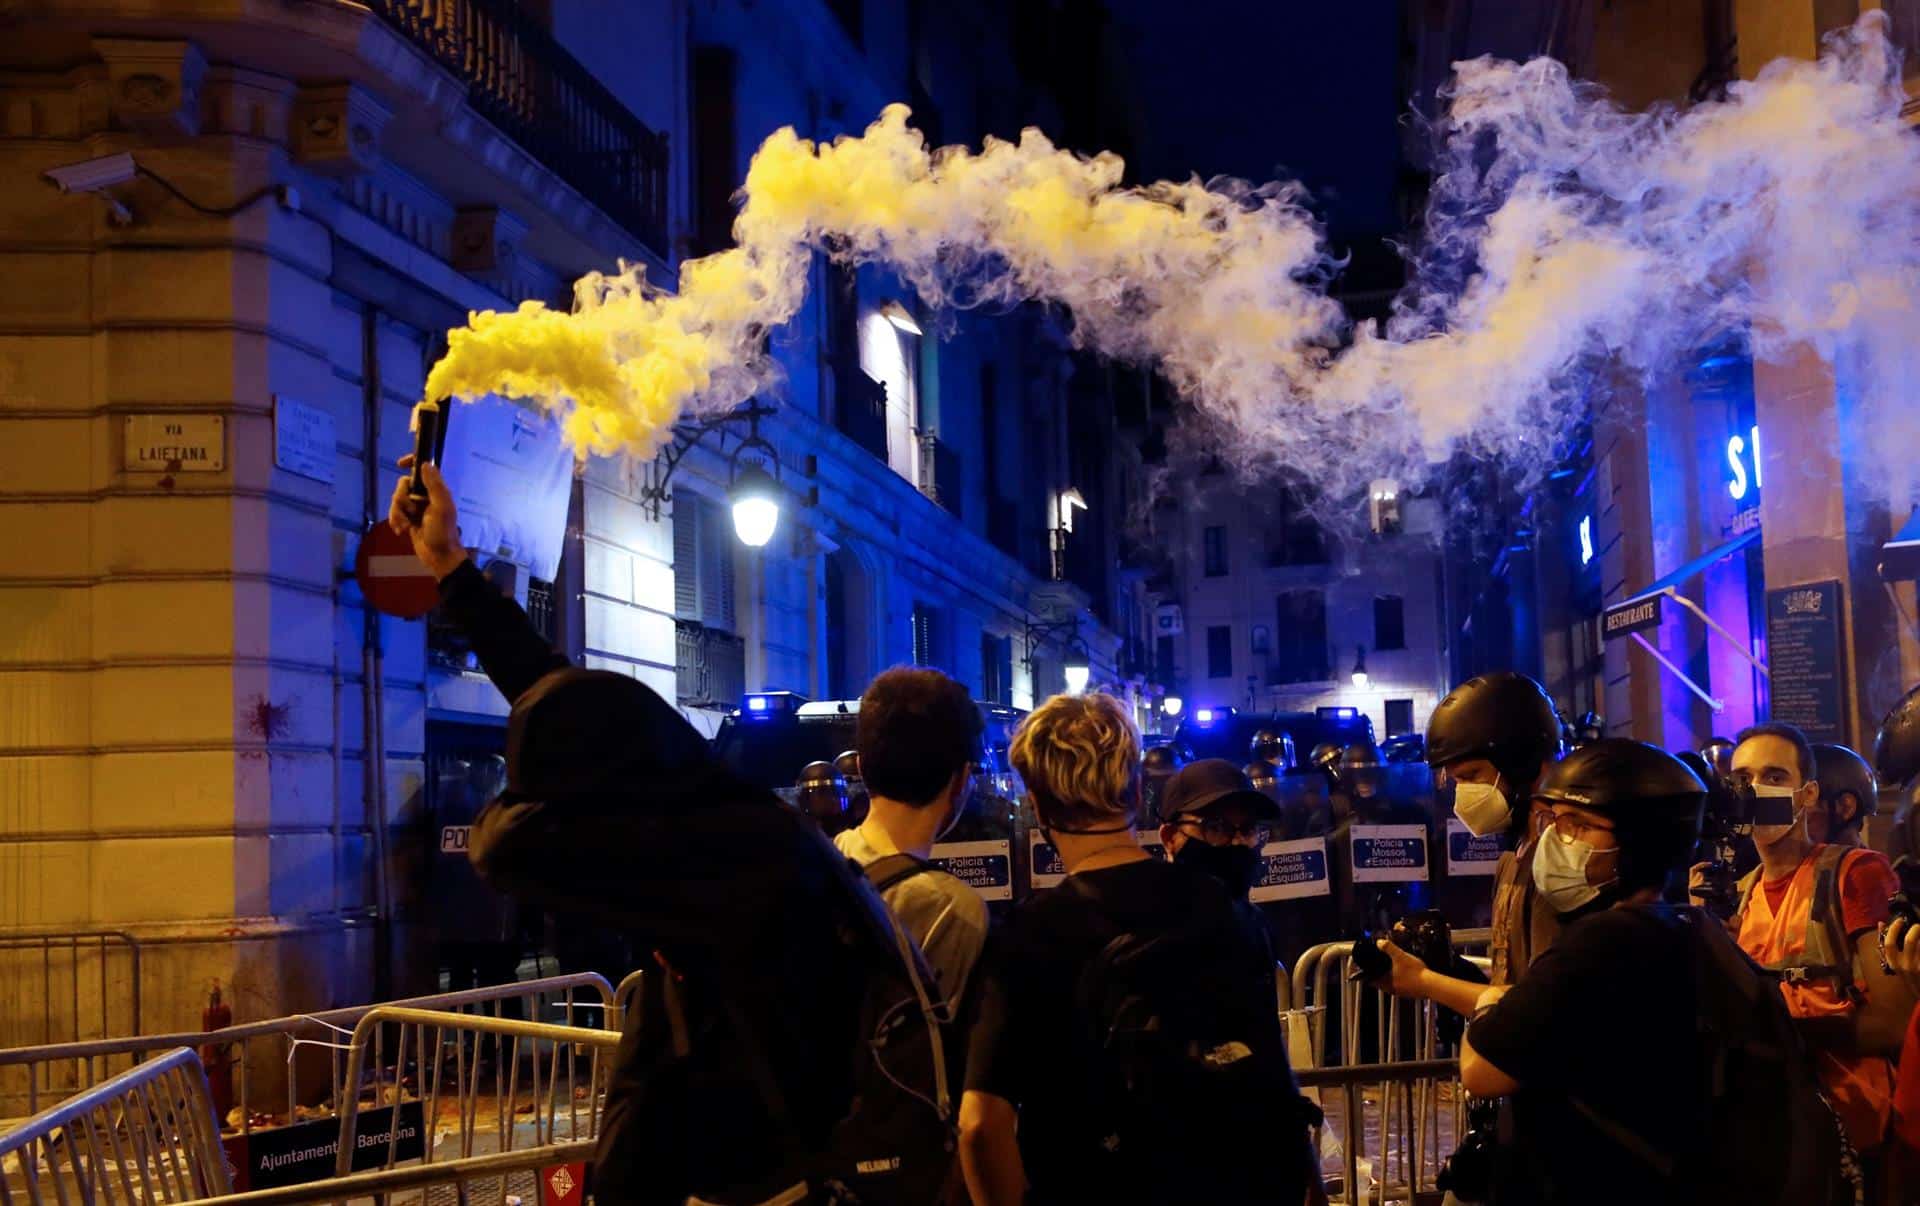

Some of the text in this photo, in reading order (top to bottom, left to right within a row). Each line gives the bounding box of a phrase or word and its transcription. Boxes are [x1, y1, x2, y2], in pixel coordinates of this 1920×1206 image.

[165, 424, 183, 435] VIA
[139, 447, 207, 461] LAIETANA
[1607, 602, 1655, 631] RESTAURANTE
[1467, 841, 1498, 849] Mossos
[1371, 847, 1407, 857] Mossos
[949, 857, 984, 868] Policia
[1270, 854, 1302, 864] Policia
[1268, 864, 1305, 874] Mossos
[260, 1126, 416, 1171] Ajuntament Barceona
